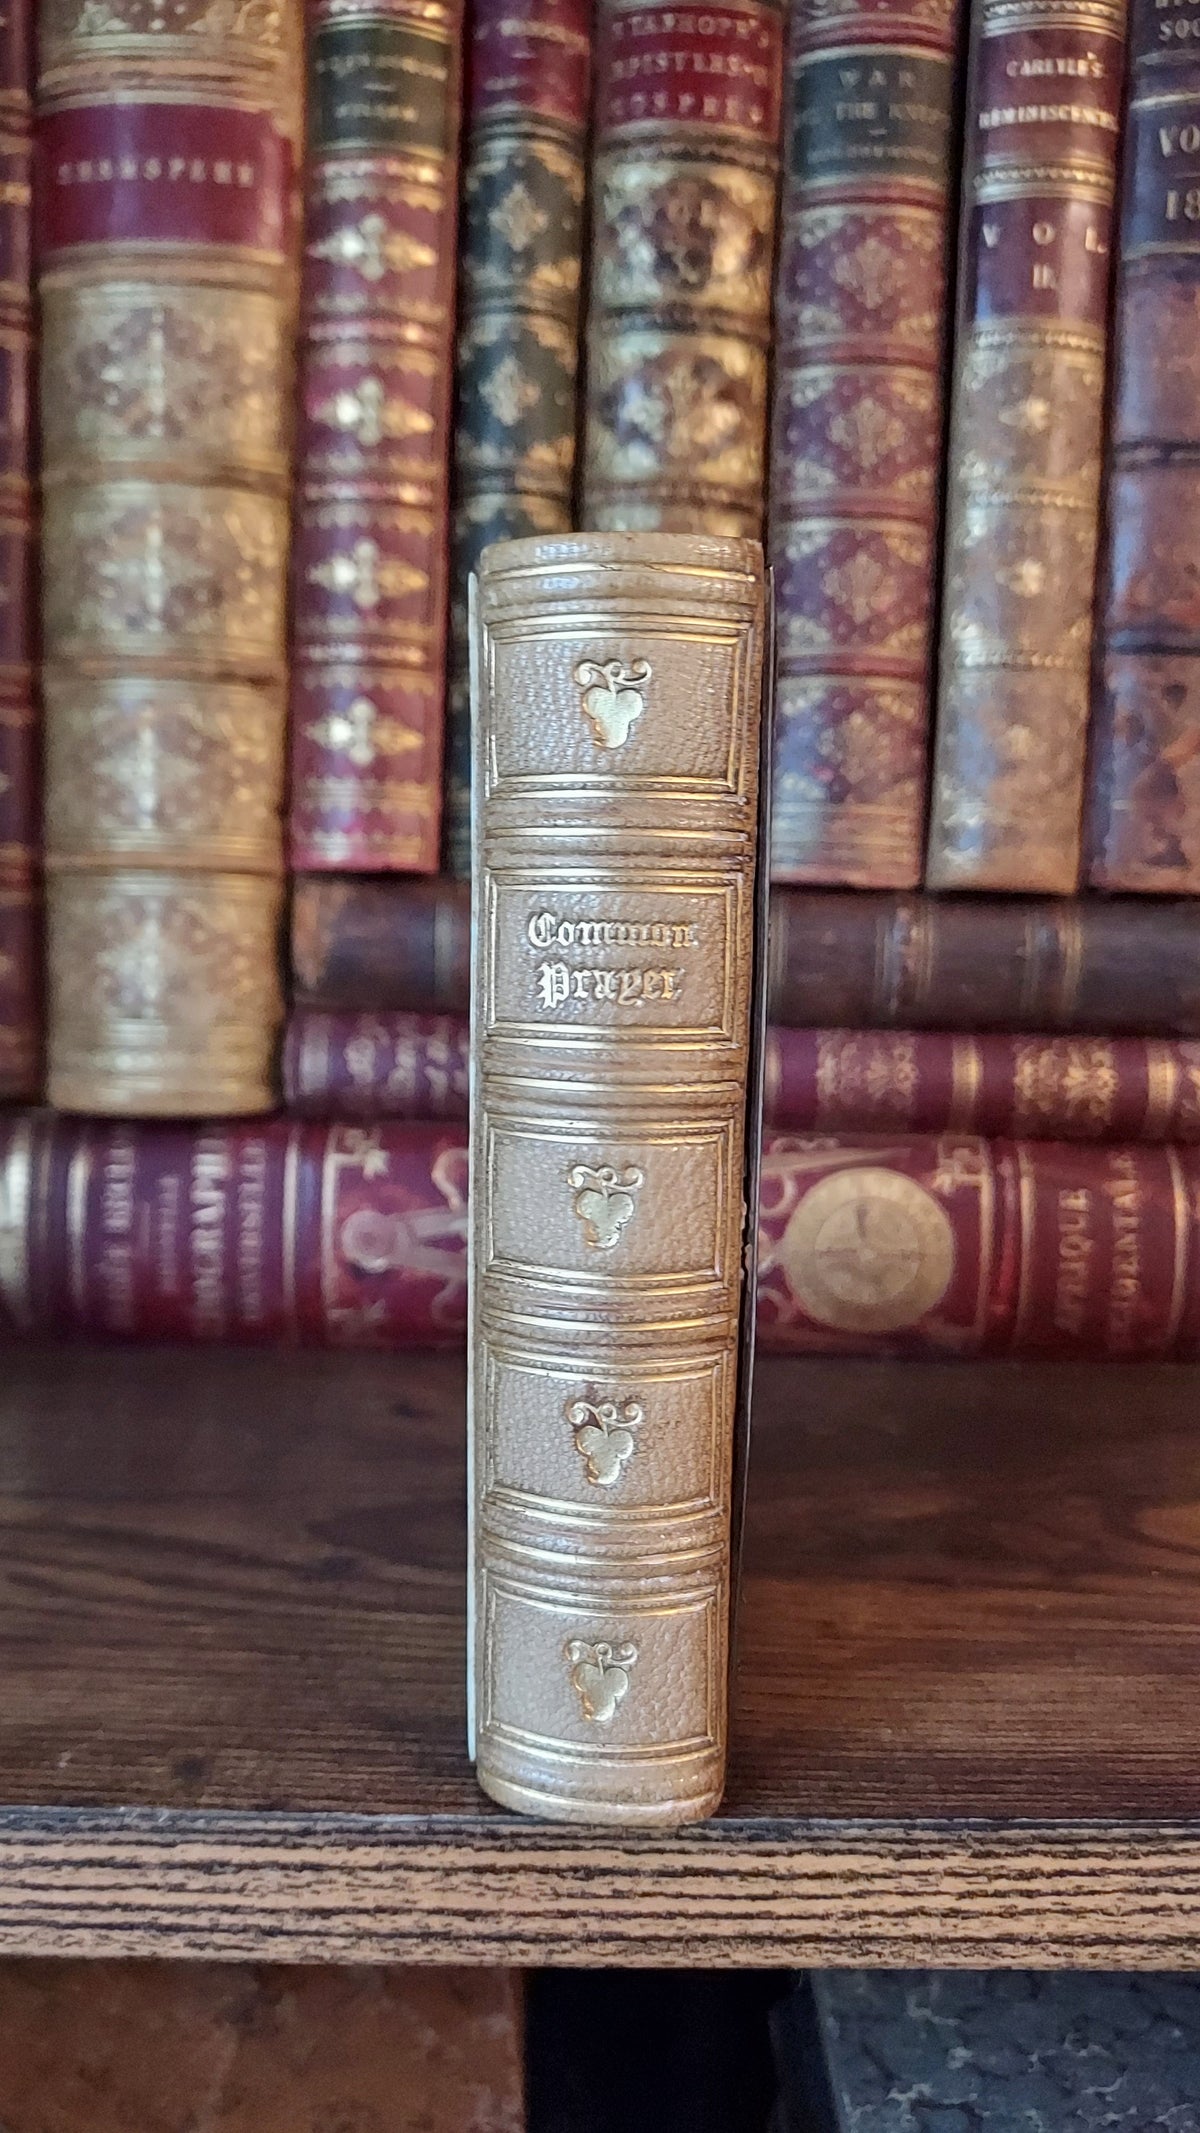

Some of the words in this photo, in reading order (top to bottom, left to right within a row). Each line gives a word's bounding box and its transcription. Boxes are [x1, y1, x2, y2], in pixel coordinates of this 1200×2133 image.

[1006, 51, 1104, 78] CARLYLE'S
[528, 911, 697, 948] Common
[535, 960, 685, 1010] Prayer
